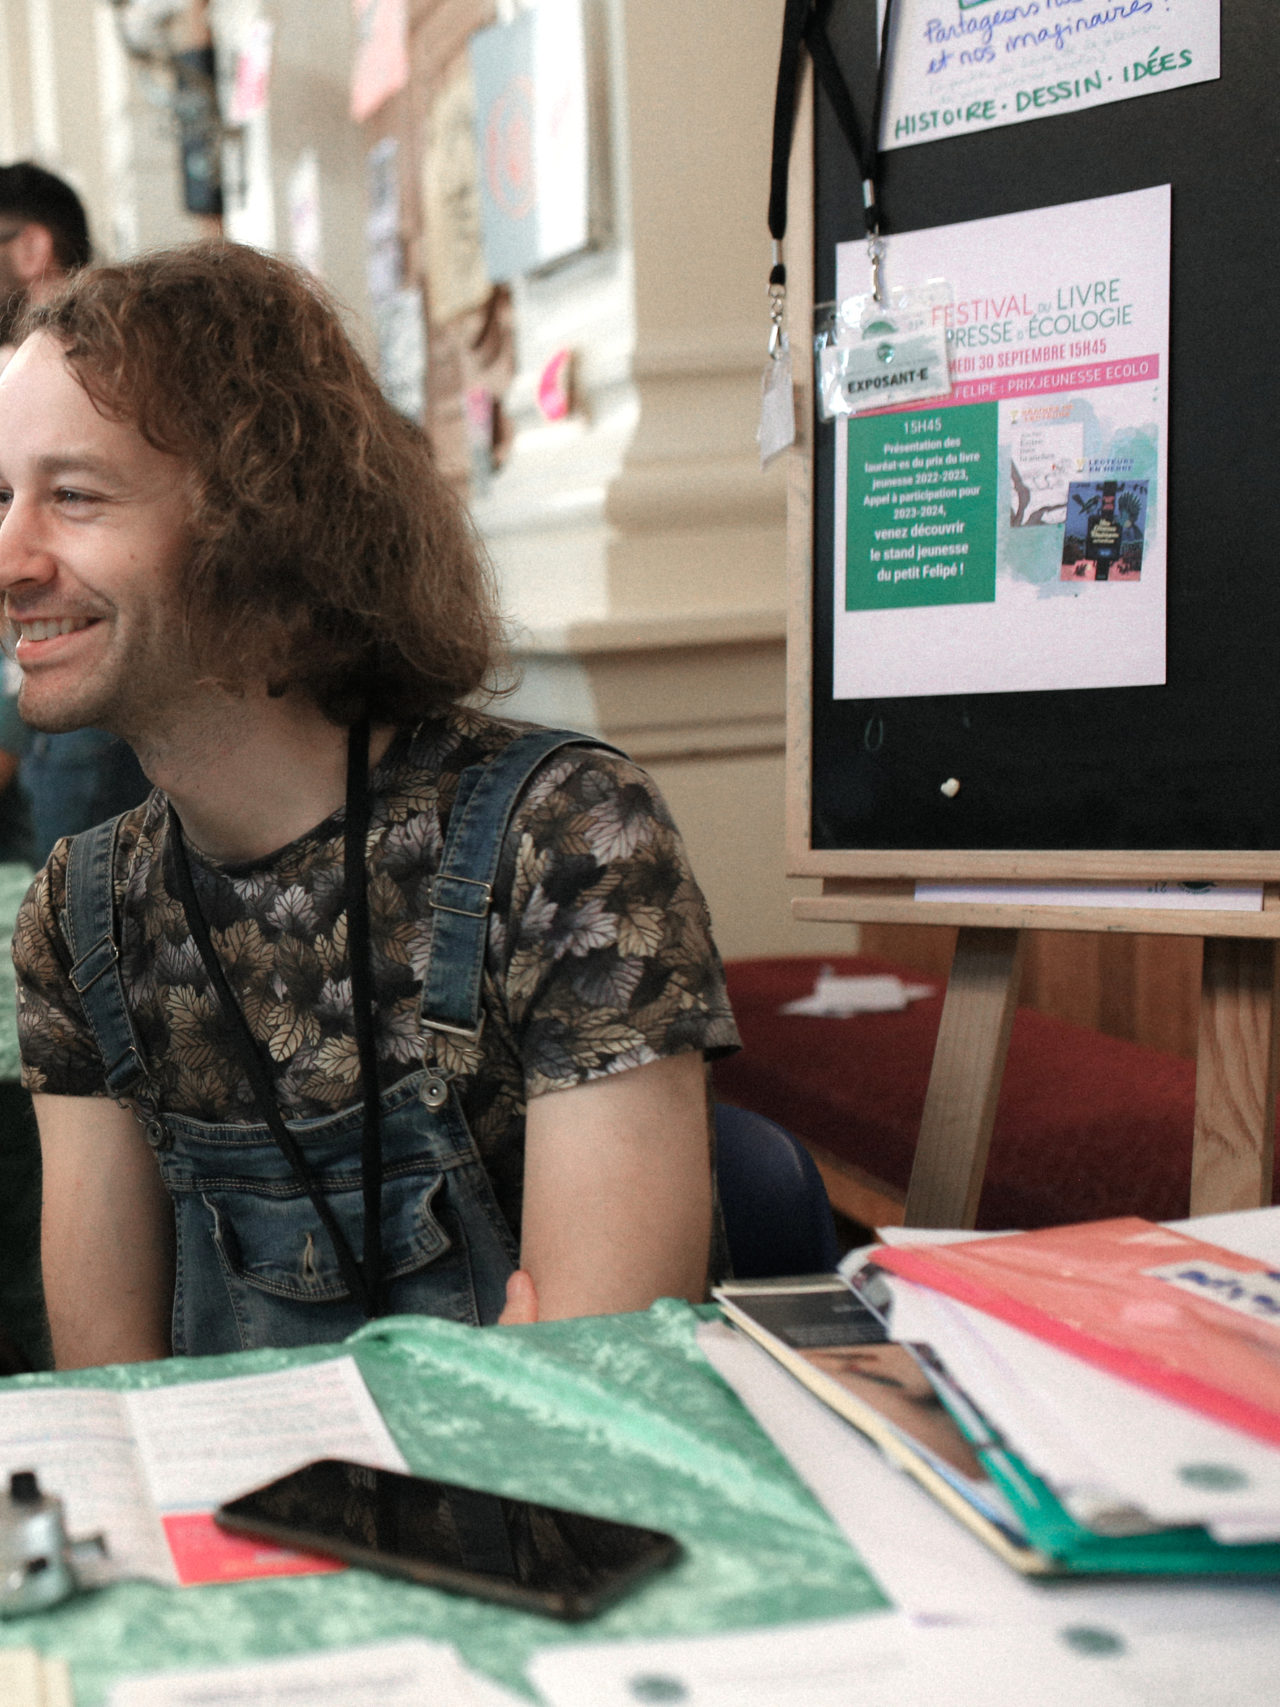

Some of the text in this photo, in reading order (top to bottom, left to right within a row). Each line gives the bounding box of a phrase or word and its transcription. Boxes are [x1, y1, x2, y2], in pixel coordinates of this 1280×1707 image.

[923, 2, 1039, 45] Partageons
[926, 52, 954, 75] et
[959, 45, 996, 65] nos
[1006, 0, 1153, 52] imaginaires
[894, 99, 996, 140] HISTOIRE
[1015, 71, 1103, 113] DESSIN
[1123, 46, 1193, 83] IDÉES
[931, 292, 1034, 328] FESTIVAL
[1057, 278, 1120, 311] LIVRE
[946, 320, 1013, 349] PRESSE
[950, 357, 975, 374] MEDI
[979, 353, 994, 371] 30
[997, 343, 1065, 369] SEPTEMBRE
[1069, 337, 1107, 358] 15H45
[954, 381, 996, 399] FELIPE
[1106, 361, 1149, 379] ECOLO
[904, 417, 942, 434] 15H45
[883, 439, 942, 455] Présentation
[911, 456, 924, 469] du
[925, 455, 943, 469] prix
[945, 453, 957, 465] du
[959, 451, 981, 463] livre
[863, 493, 891, 507] Appel
[898, 487, 957, 505] participation
[958, 486, 981, 500] pour
[874, 520, 966, 541] venez découvrir
[870, 543, 969, 562] le stand jeunesse
[877, 567, 892, 582] du
[894, 565, 921, 584] petit
[922, 562, 958, 580] Felipé
